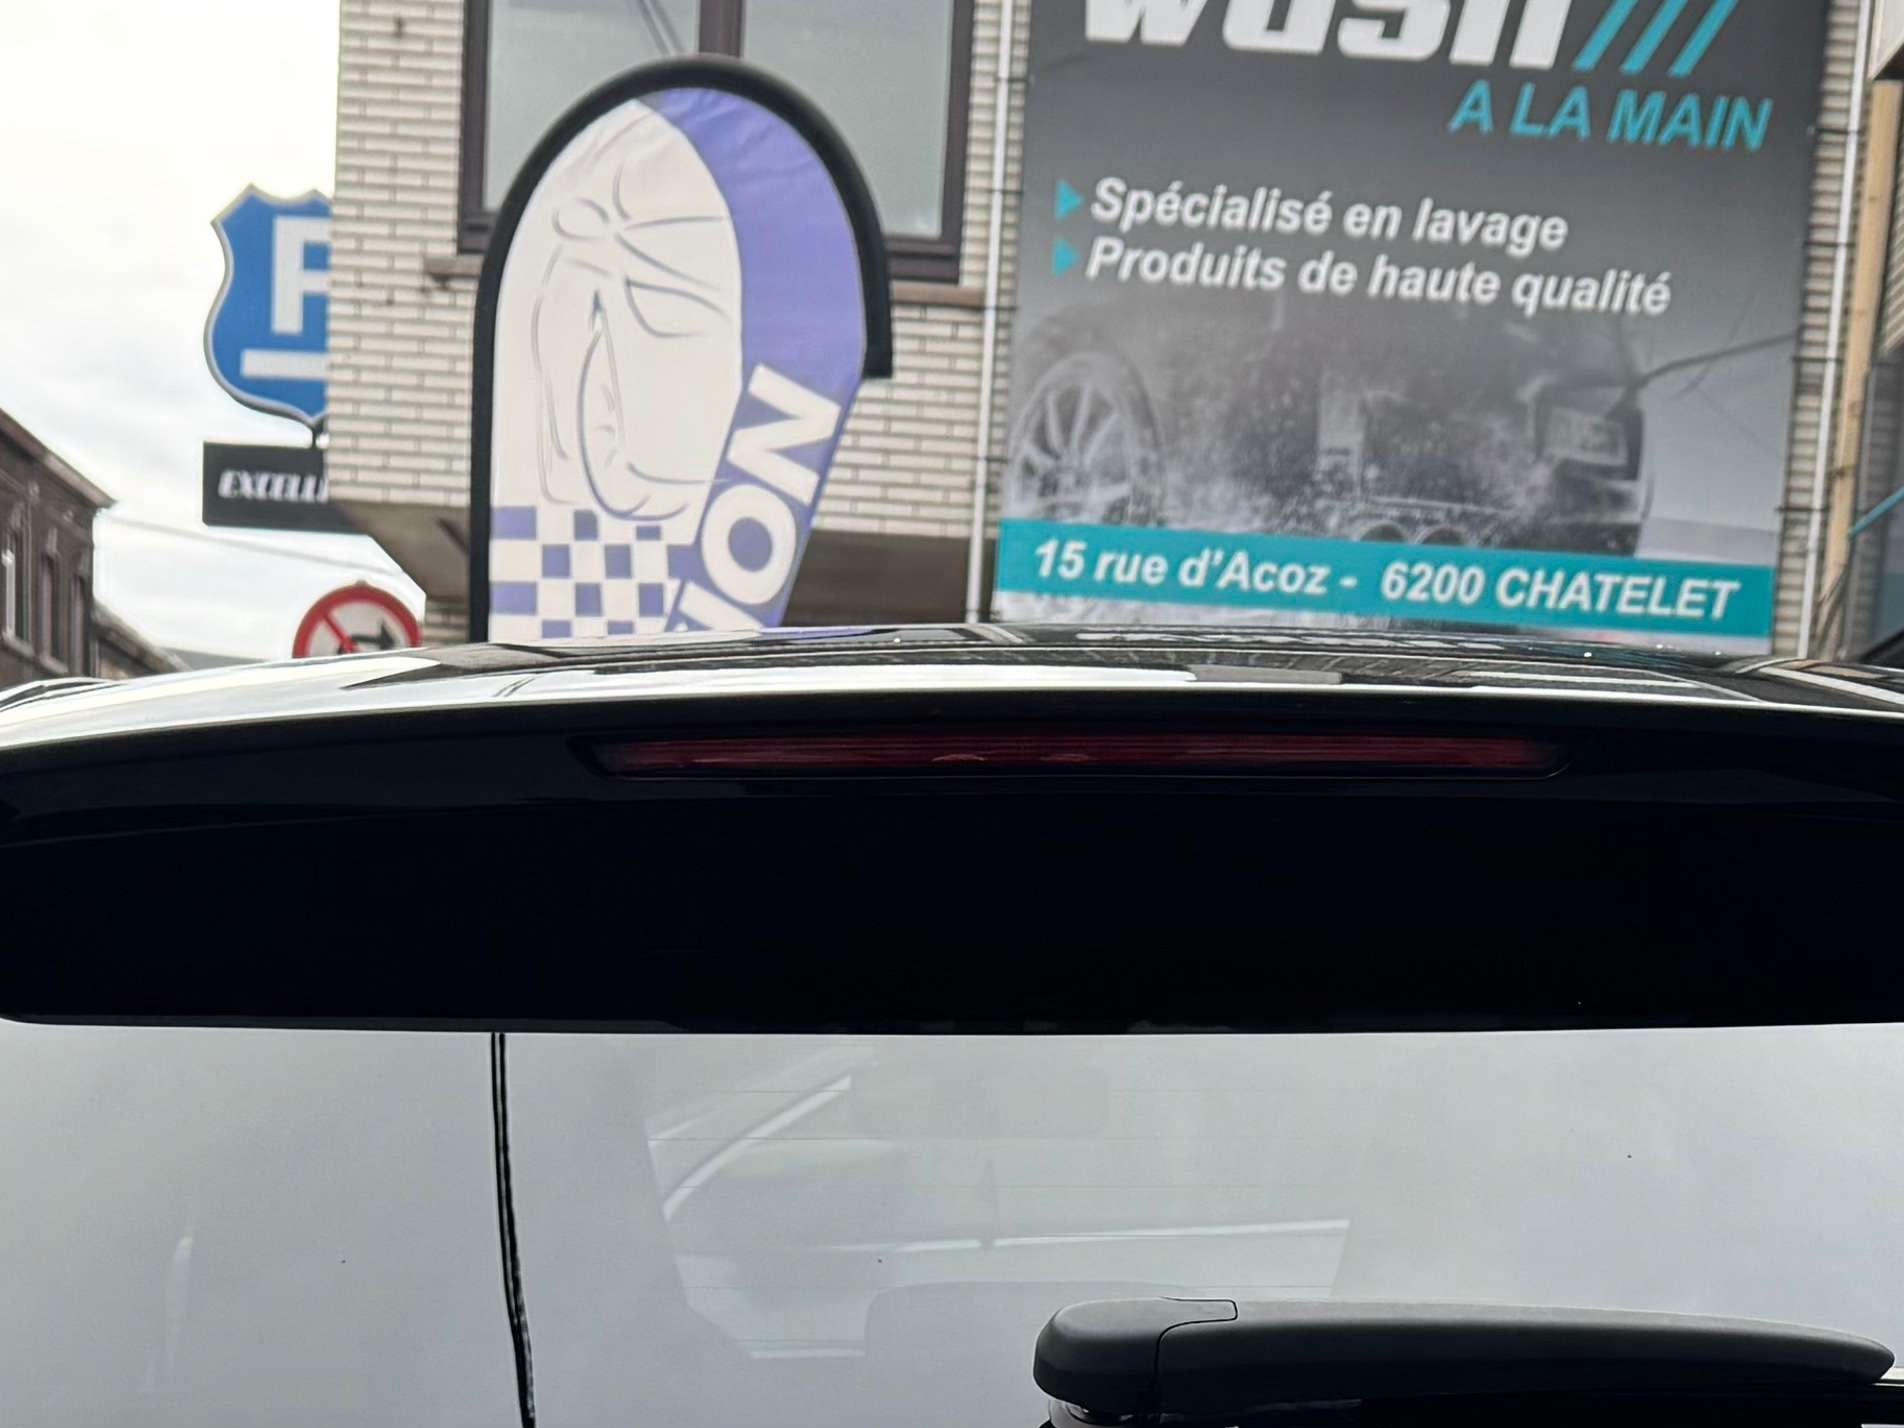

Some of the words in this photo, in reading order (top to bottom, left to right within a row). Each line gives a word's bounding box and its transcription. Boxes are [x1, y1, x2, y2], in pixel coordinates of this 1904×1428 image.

[1449, 78, 1491, 134] A
[1509, 83, 1591, 141] LA
[1607, 89, 1773, 152] MAIN
[1090, 176, 1332, 236] Spécialisé
[1343, 203, 1402, 241] en
[1412, 198, 1569, 257] lavage
[1086, 237, 1286, 290] Produits
[1297, 252, 1358, 296] de
[1366, 255, 1501, 304] haute
[1511, 268, 1672, 318] qualité
[1034, 539, 1086, 580] 15
[1095, 551, 1169, 585] rue
[1178, 549, 1327, 597] d'Acoz
[1379, 560, 1486, 605] 6200
[1496, 567, 1741, 620] CHATELET
